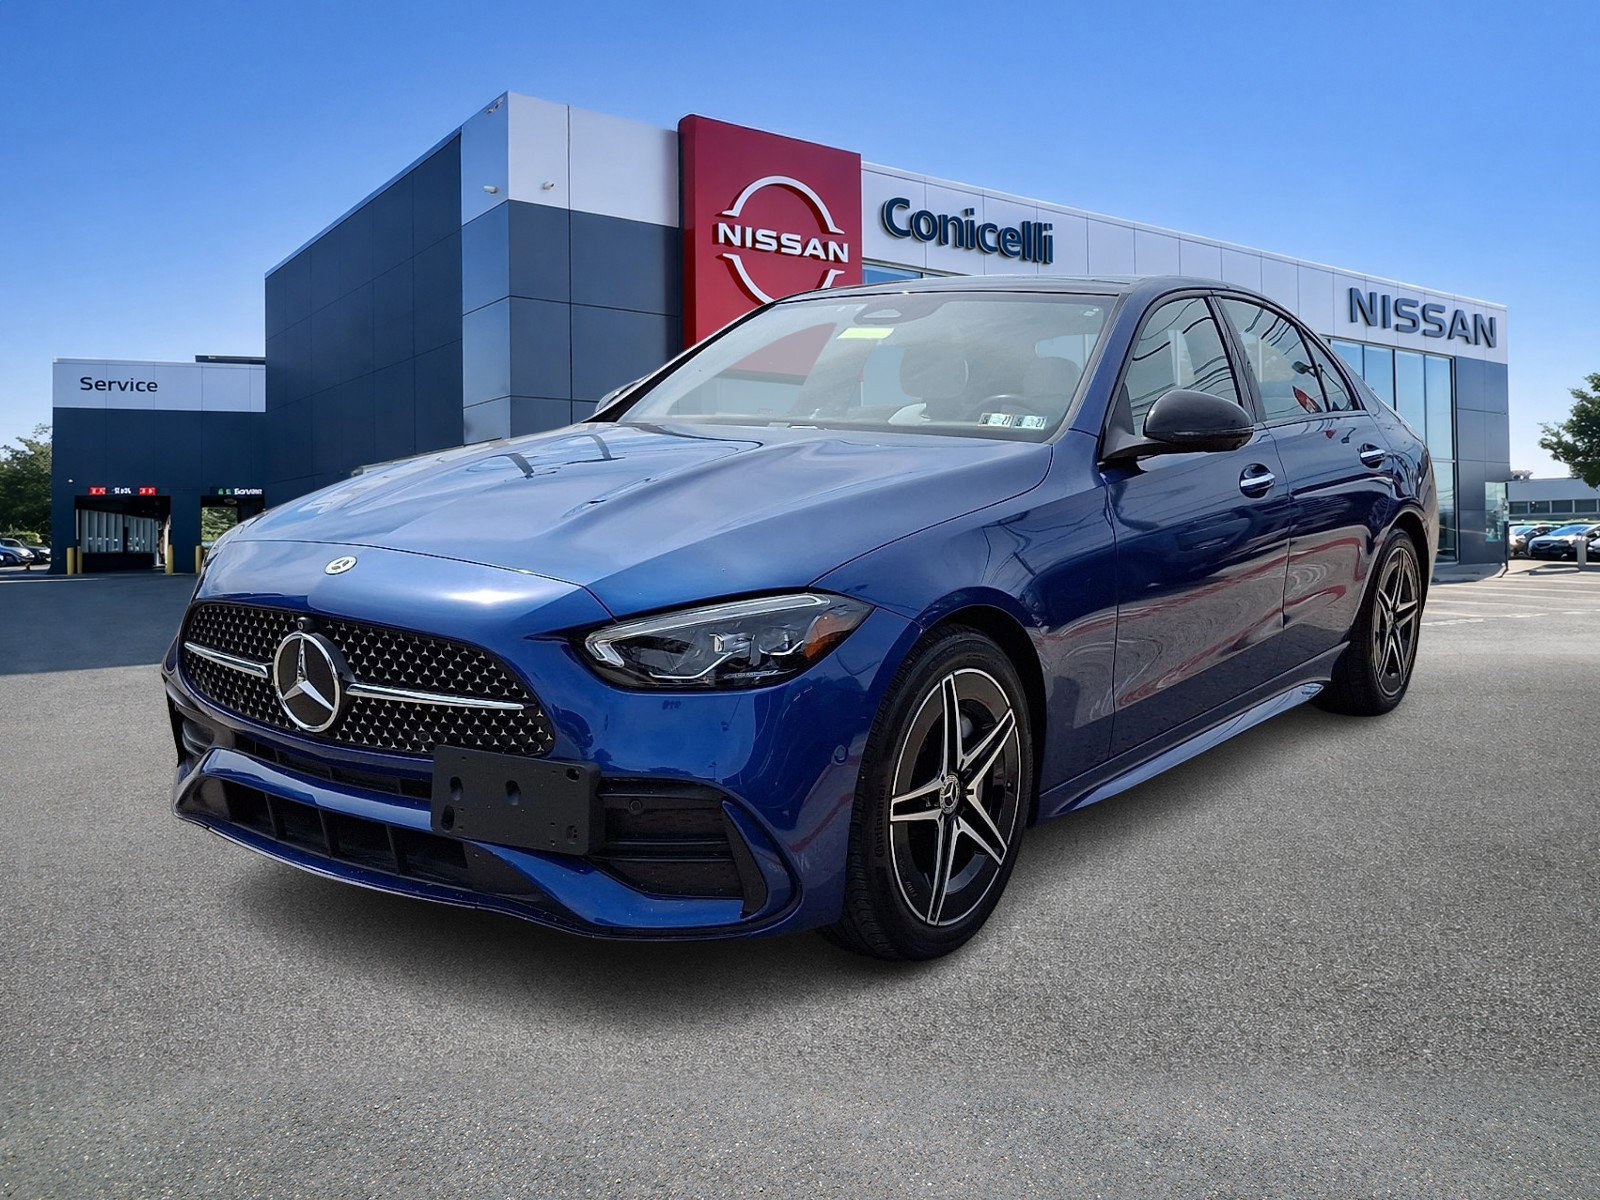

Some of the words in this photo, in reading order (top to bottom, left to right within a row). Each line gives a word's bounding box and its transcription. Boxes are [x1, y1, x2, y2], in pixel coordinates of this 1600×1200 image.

[717, 222, 849, 263] NISSAN
[882, 196, 1053, 264] Conicelli
[1349, 287, 1497, 348] NISSAN
[80, 377, 158, 392] Service
